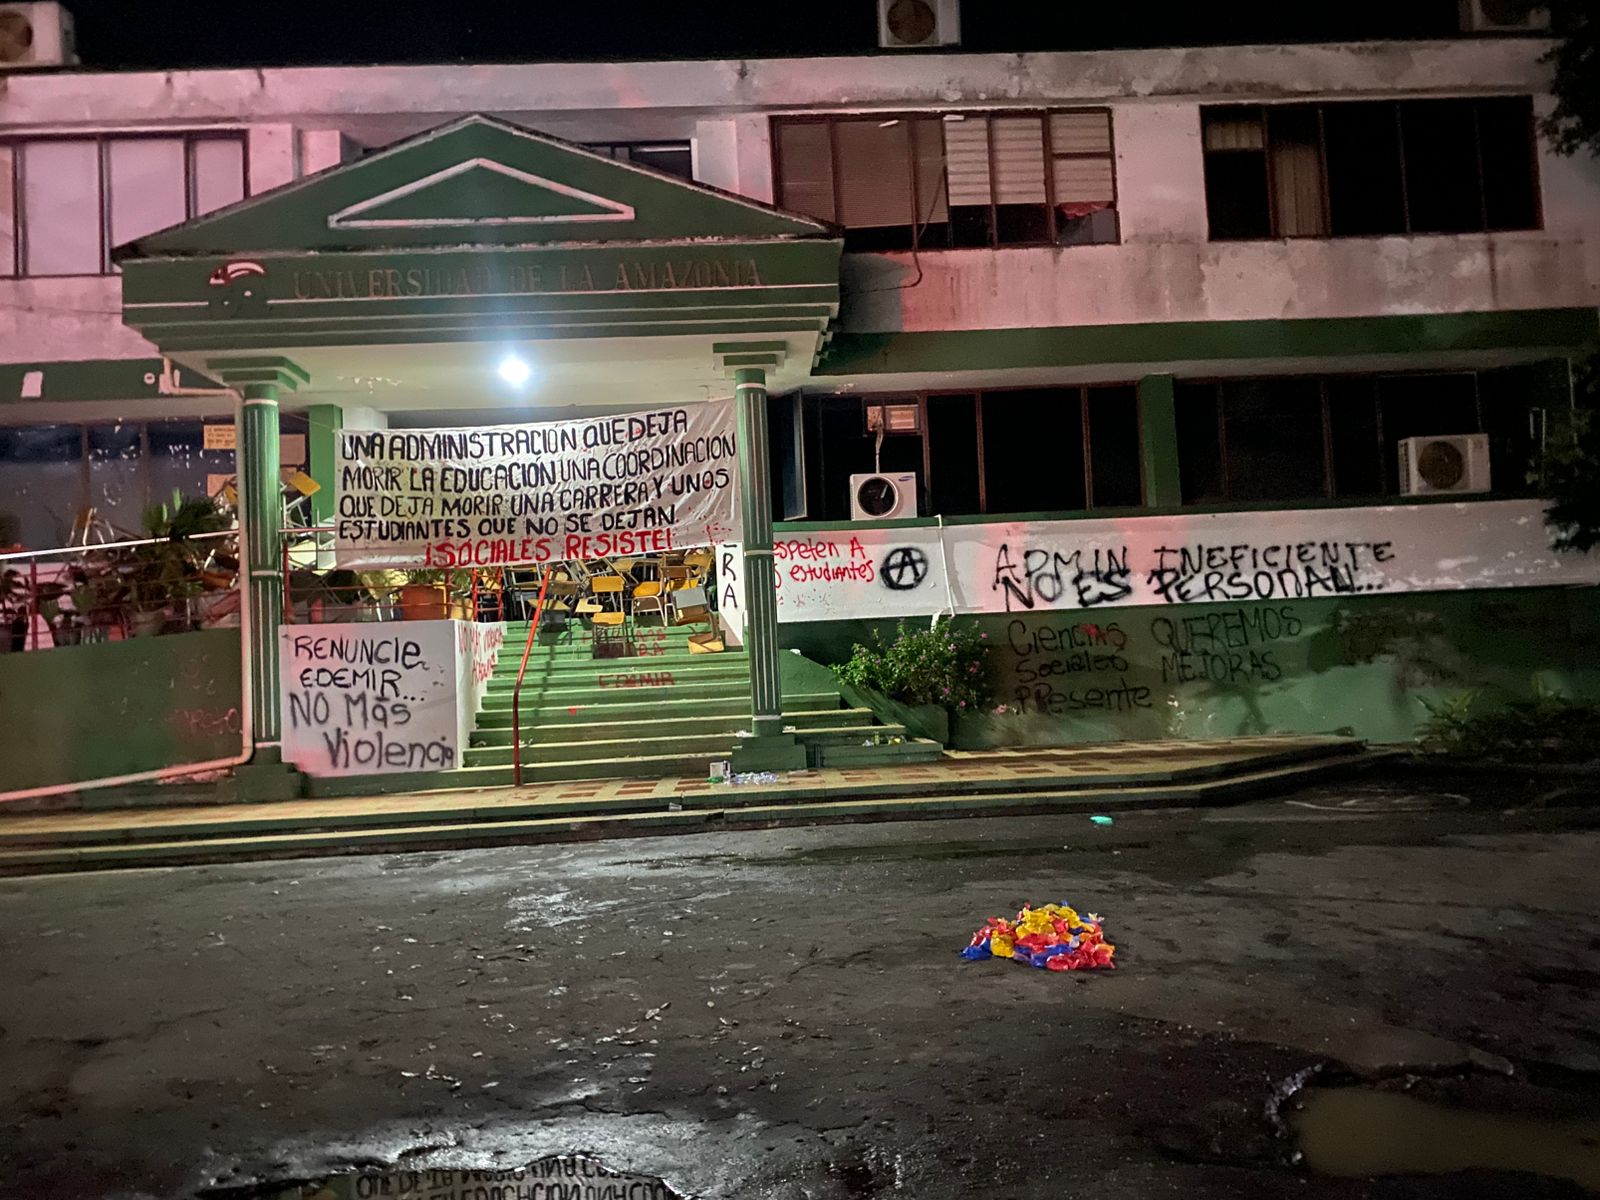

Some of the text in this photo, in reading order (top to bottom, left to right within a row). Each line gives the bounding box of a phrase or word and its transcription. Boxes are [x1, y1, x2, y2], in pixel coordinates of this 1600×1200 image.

[293, 259, 762, 299] UNIVERSIDAD DE LA AMAZONIA
[341, 432, 384, 461] UNA
[582, 418, 624, 448] QUE
[627, 410, 687, 443] DEJA
[342, 430, 737, 493] MORIR LA EDUCACIÓN UNA COORDINACIÓN
[339, 467, 730, 518] QUE DEJA MORIR UNA CARRERA Y UNOS
[339, 518, 471, 543] ESTUDIANTES
[477, 517, 516, 537] QUE
[525, 515, 559, 536] NO
[566, 513, 593, 533] SE
[773, 536, 866, 561] espeten A
[1152, 541, 1396, 577] INEFICIENTE
[1002, 575, 1063, 612] NO
[1151, 605, 1303, 655] QUEREMOS
[1161, 648, 1282, 684] MEJORAS
[288, 690, 330, 729] NO
